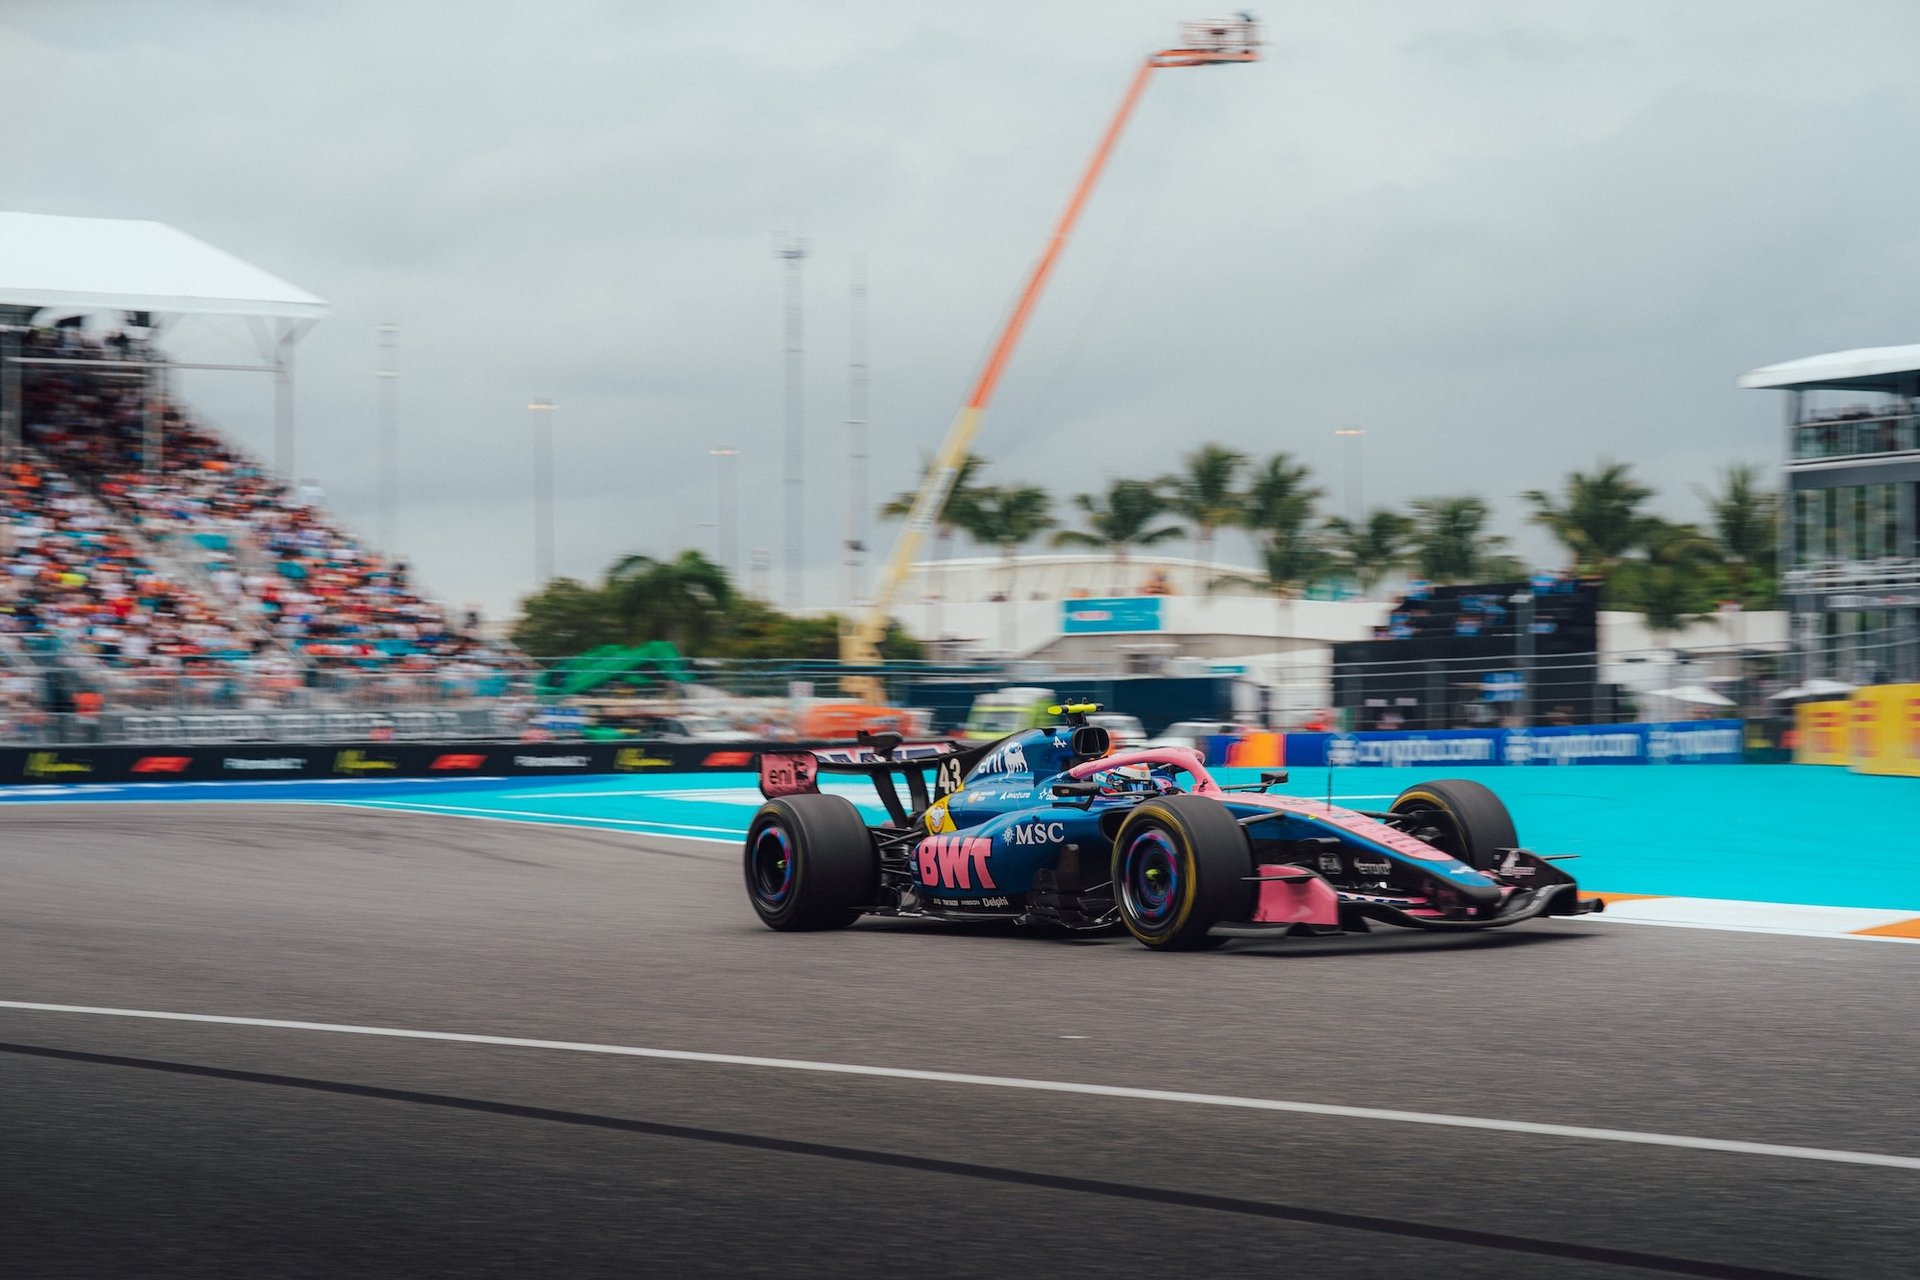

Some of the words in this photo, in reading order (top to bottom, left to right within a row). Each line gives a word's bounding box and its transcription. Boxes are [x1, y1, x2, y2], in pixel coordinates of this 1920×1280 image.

[978, 746, 1005, 774] eni
[769, 762, 792, 785] eni
[939, 758, 962, 794] 43
[1015, 822, 1065, 845] MSC
[918, 836, 997, 890] BWT
[981, 896, 1009, 908] Delphi
